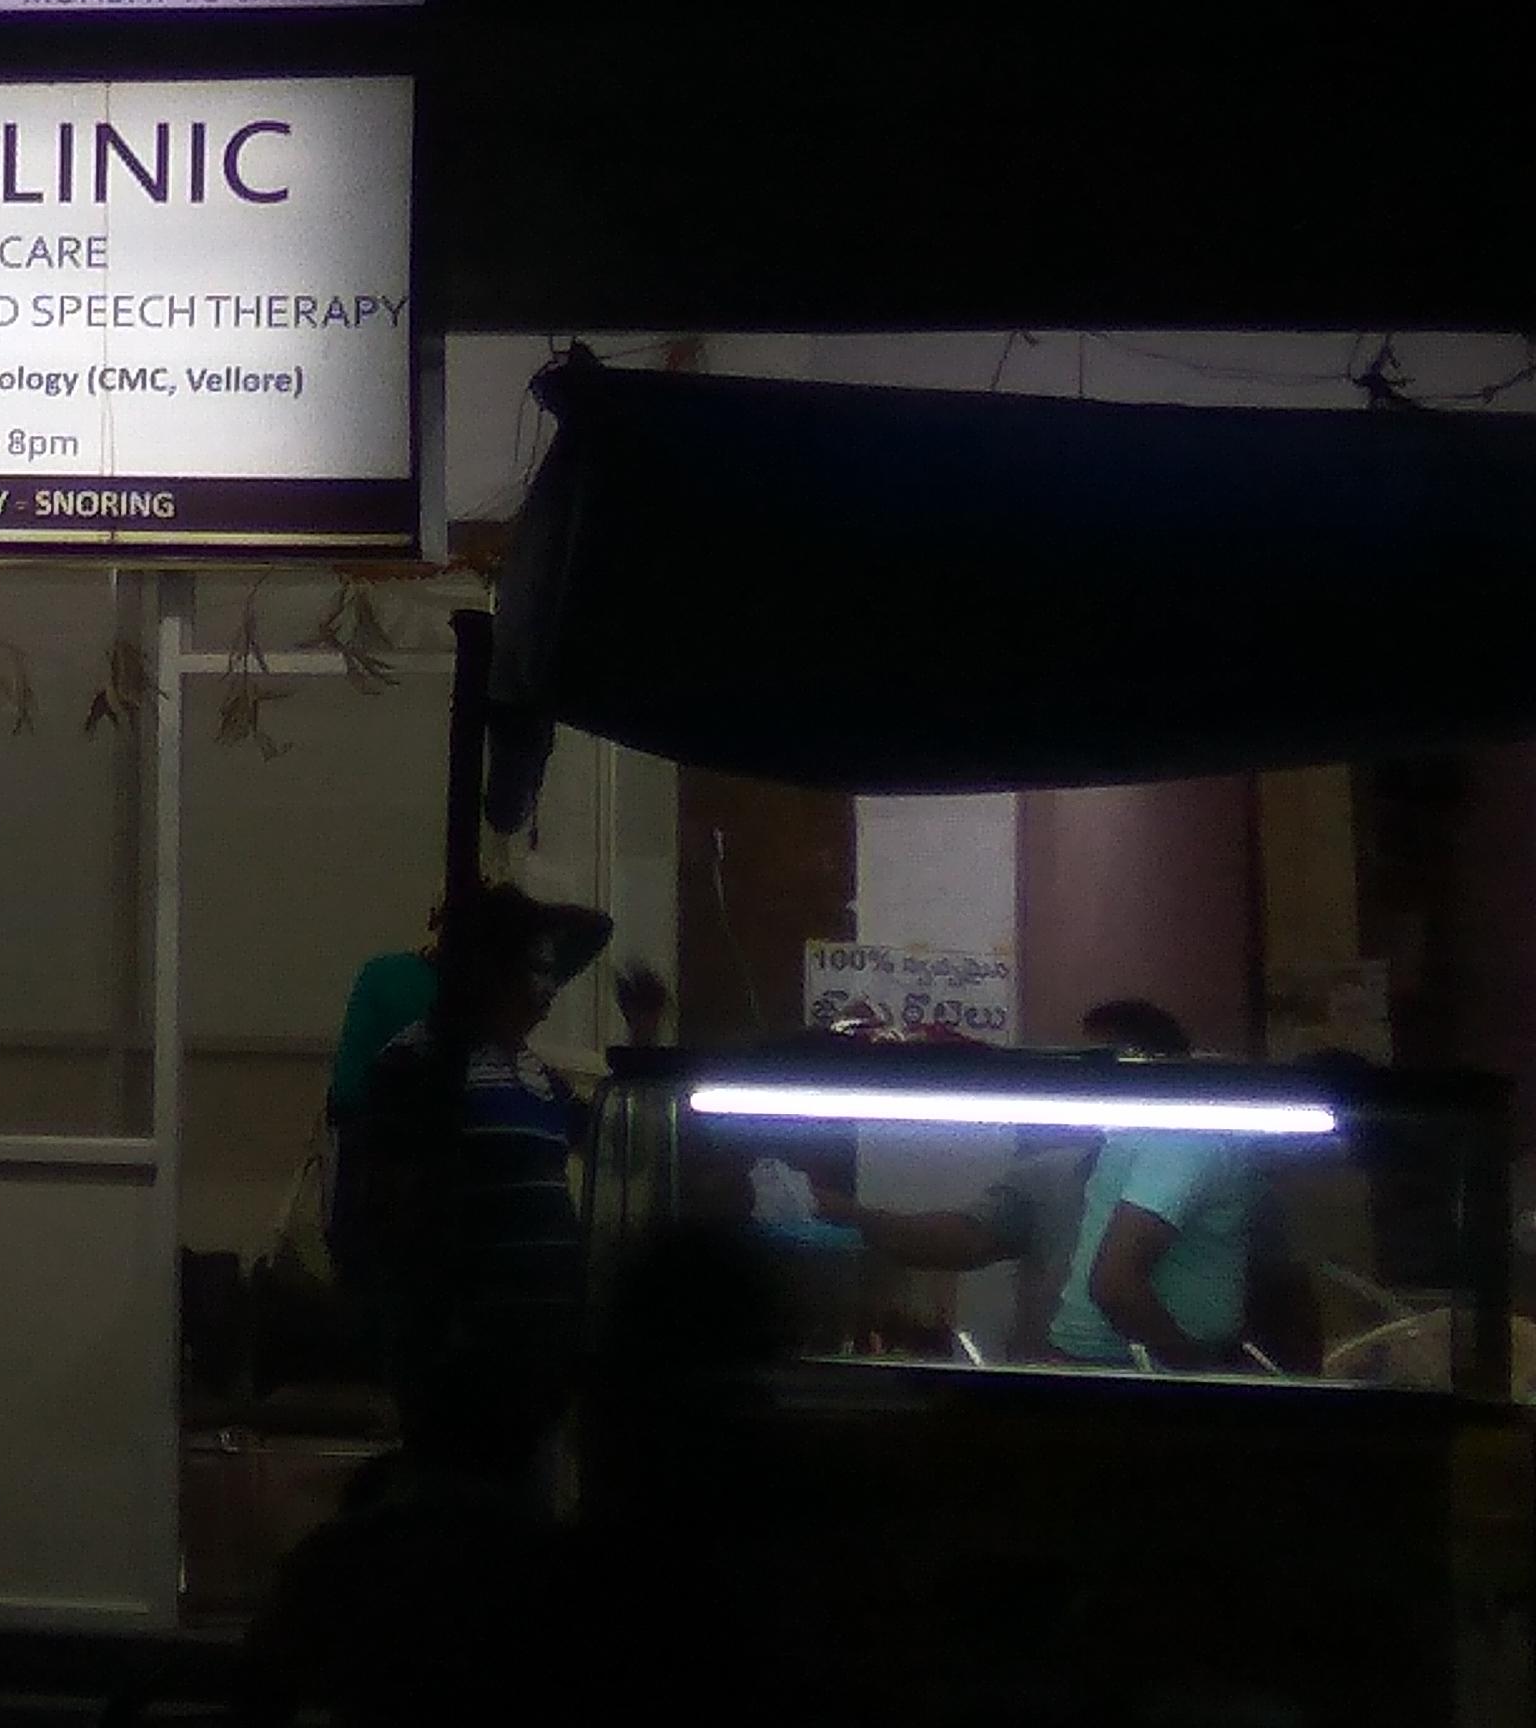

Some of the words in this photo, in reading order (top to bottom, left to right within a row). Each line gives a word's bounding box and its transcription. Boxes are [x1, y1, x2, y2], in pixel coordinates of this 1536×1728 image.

[31, 294, 196, 329] SPEECH
[204, 294, 412, 329] THERAPY
[87, 365, 178, 397] (CMC,
[185, 366, 305, 397] Vellore)
[6, 429, 79, 459] 8pm
[33, 489, 178, 518] SNORING
